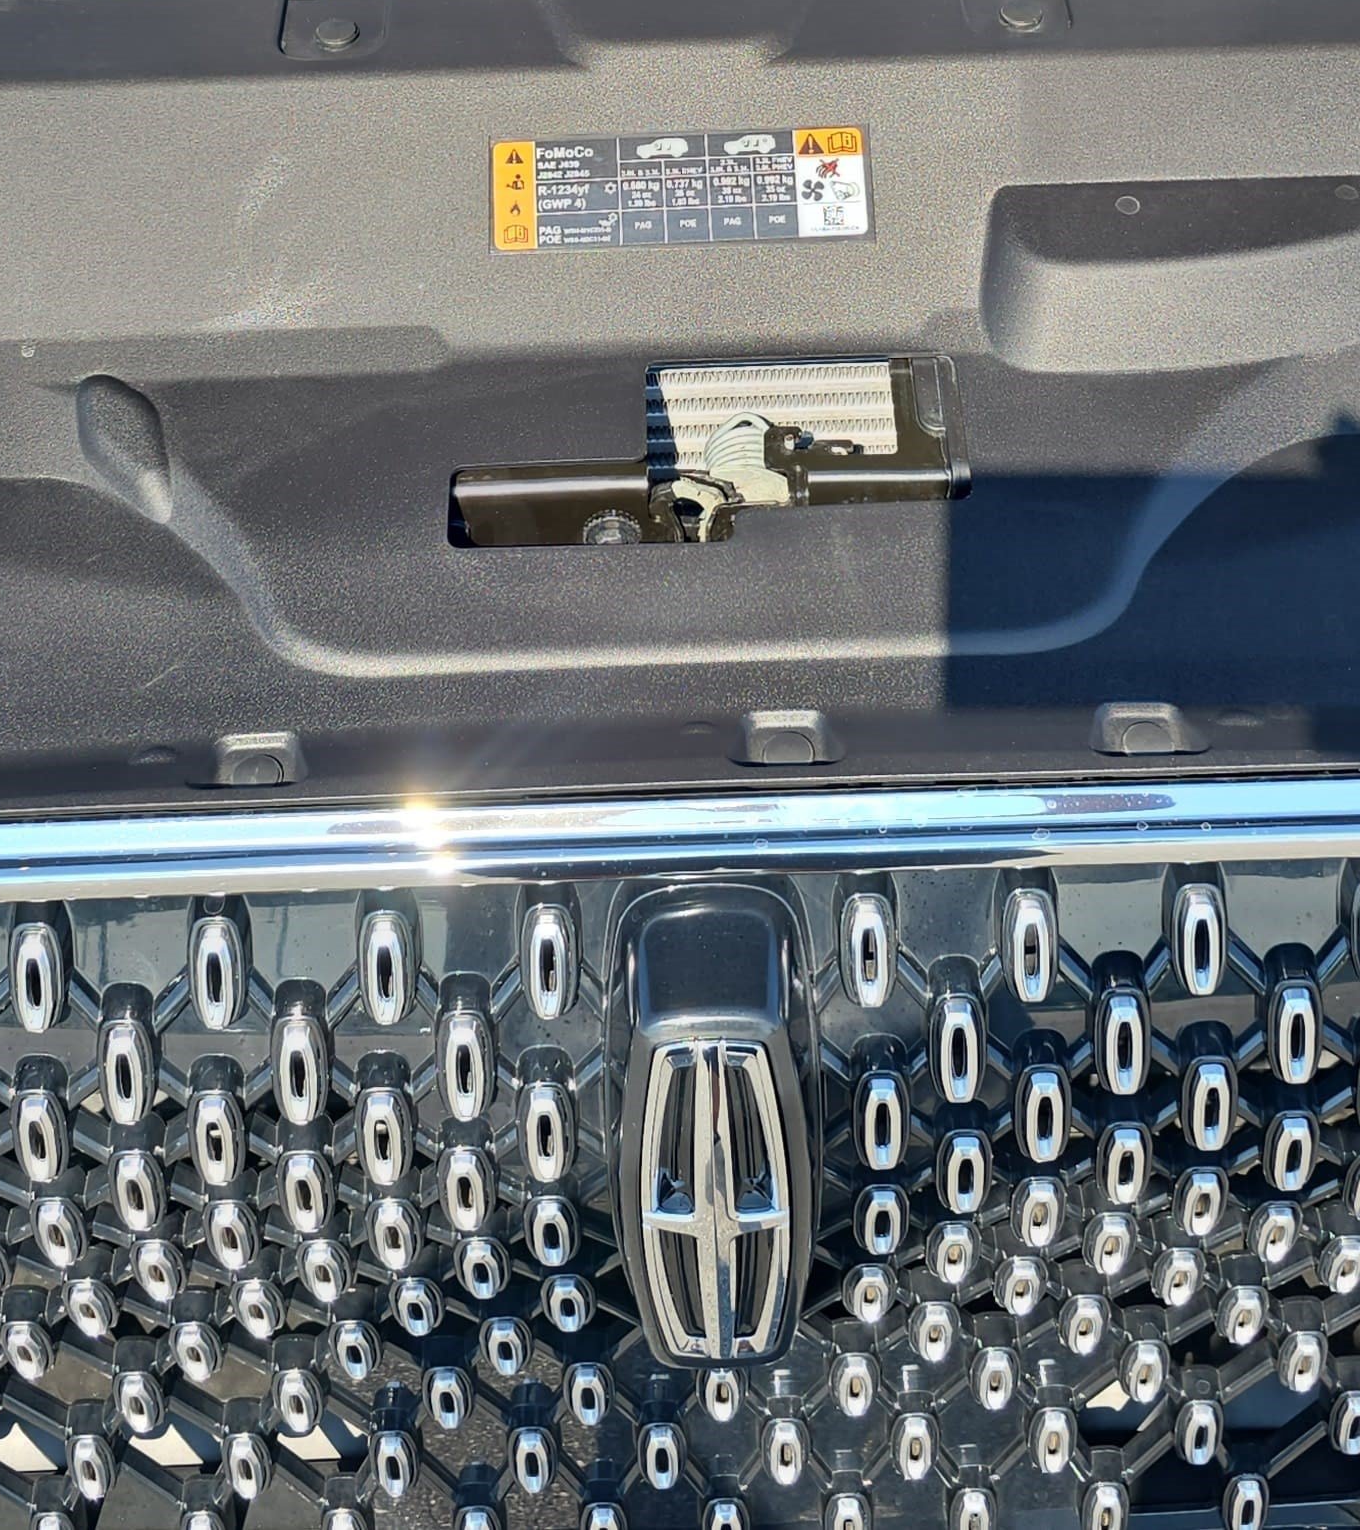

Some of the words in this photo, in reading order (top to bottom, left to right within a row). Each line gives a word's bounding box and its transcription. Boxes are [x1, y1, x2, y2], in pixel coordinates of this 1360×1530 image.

[536, 146, 594, 159] FoMoCo
[537, 161, 556, 169] SAE
[666, 179, 689, 189] 0.737
[691, 179, 703, 190] kg
[738, 176, 750, 187] kg
[782, 175, 794, 186] kg
[538, 183, 590, 196] R-1234yf
[648, 181, 660, 191] kg
[538, 199, 572, 211] (GWP
[574, 198, 587, 210] 4)
[679, 218, 697, 228] POE
[723, 217, 742, 226] PAG
[768, 214, 786, 224] POE
[539, 226, 562, 235] PAG
[634, 221, 653, 230] PAG
[539, 235, 562, 244] POE
